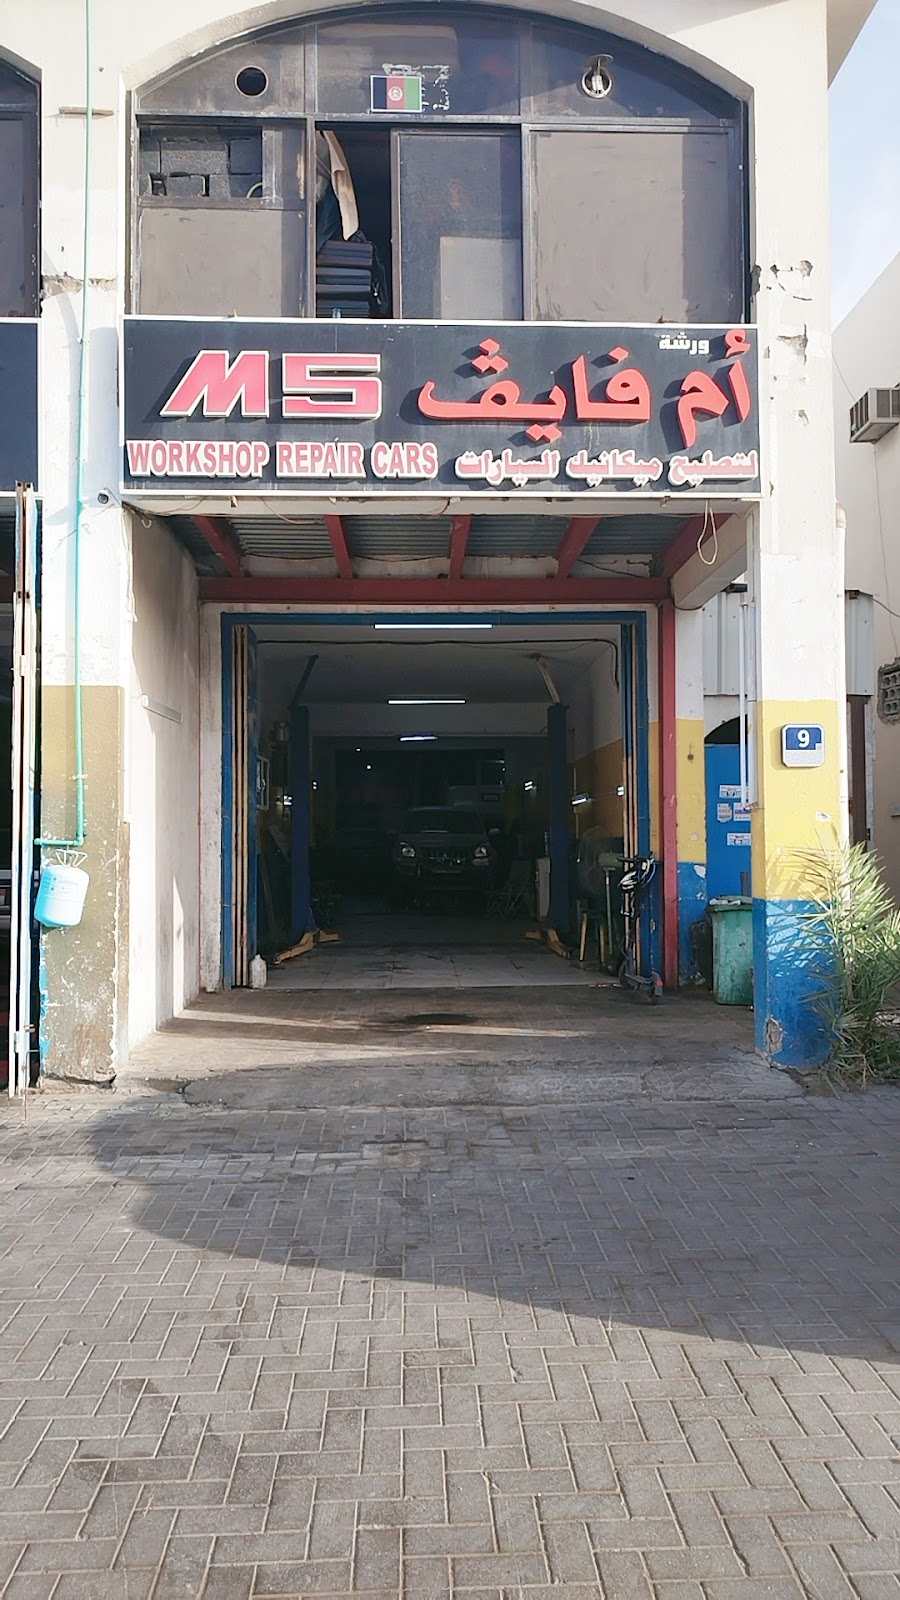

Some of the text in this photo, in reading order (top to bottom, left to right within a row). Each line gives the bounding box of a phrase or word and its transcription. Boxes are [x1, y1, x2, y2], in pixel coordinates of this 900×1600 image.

[658, 331, 710, 356] ورشة
[160, 349, 383, 419] M5
[677, 329, 751, 449] أم
[126, 440, 438, 479] WORKSHOP REPAIR CARS
[454, 448, 759, 488] لتصليح ميكانيك السيارات
[797, 729, 810, 748] 9
